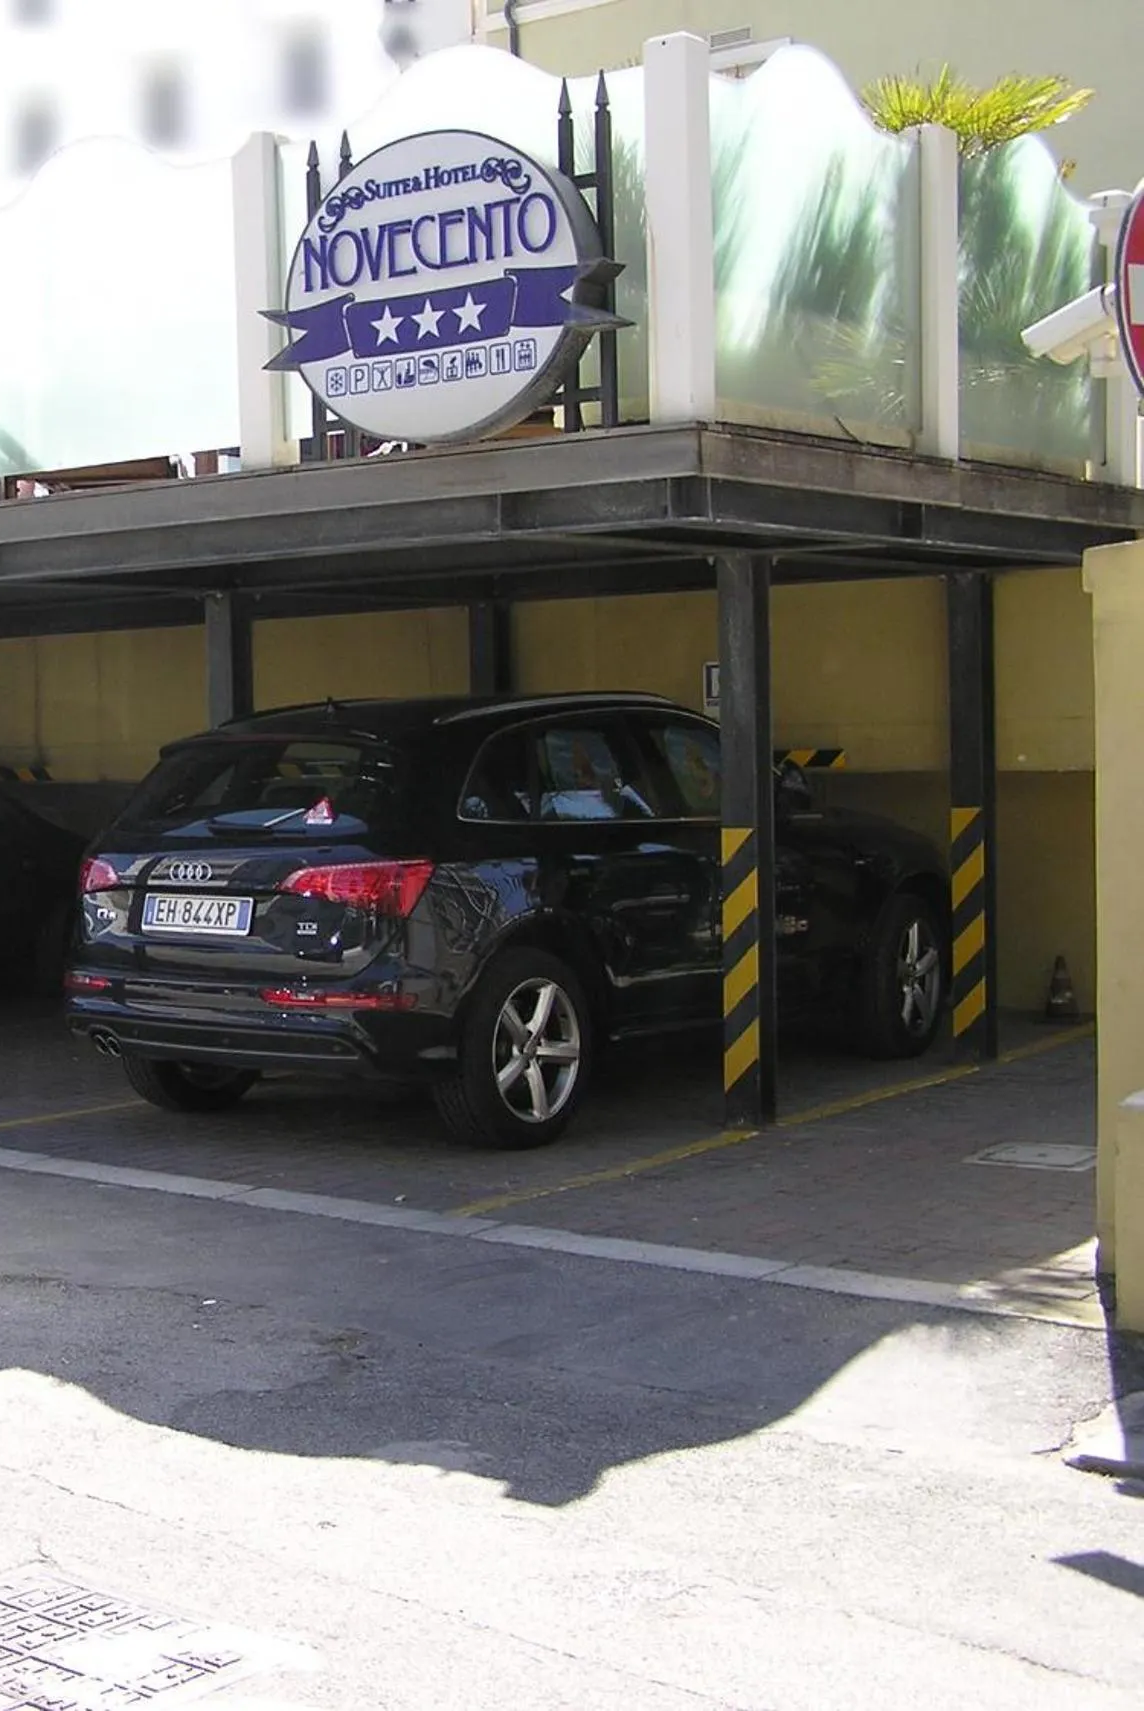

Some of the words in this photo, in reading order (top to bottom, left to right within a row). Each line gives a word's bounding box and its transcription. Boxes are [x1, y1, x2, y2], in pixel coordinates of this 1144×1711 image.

[303, 191, 557, 293] NOVECENTO
[155, 899, 178, 923] EH
[181, 900, 237, 927] 844XP
